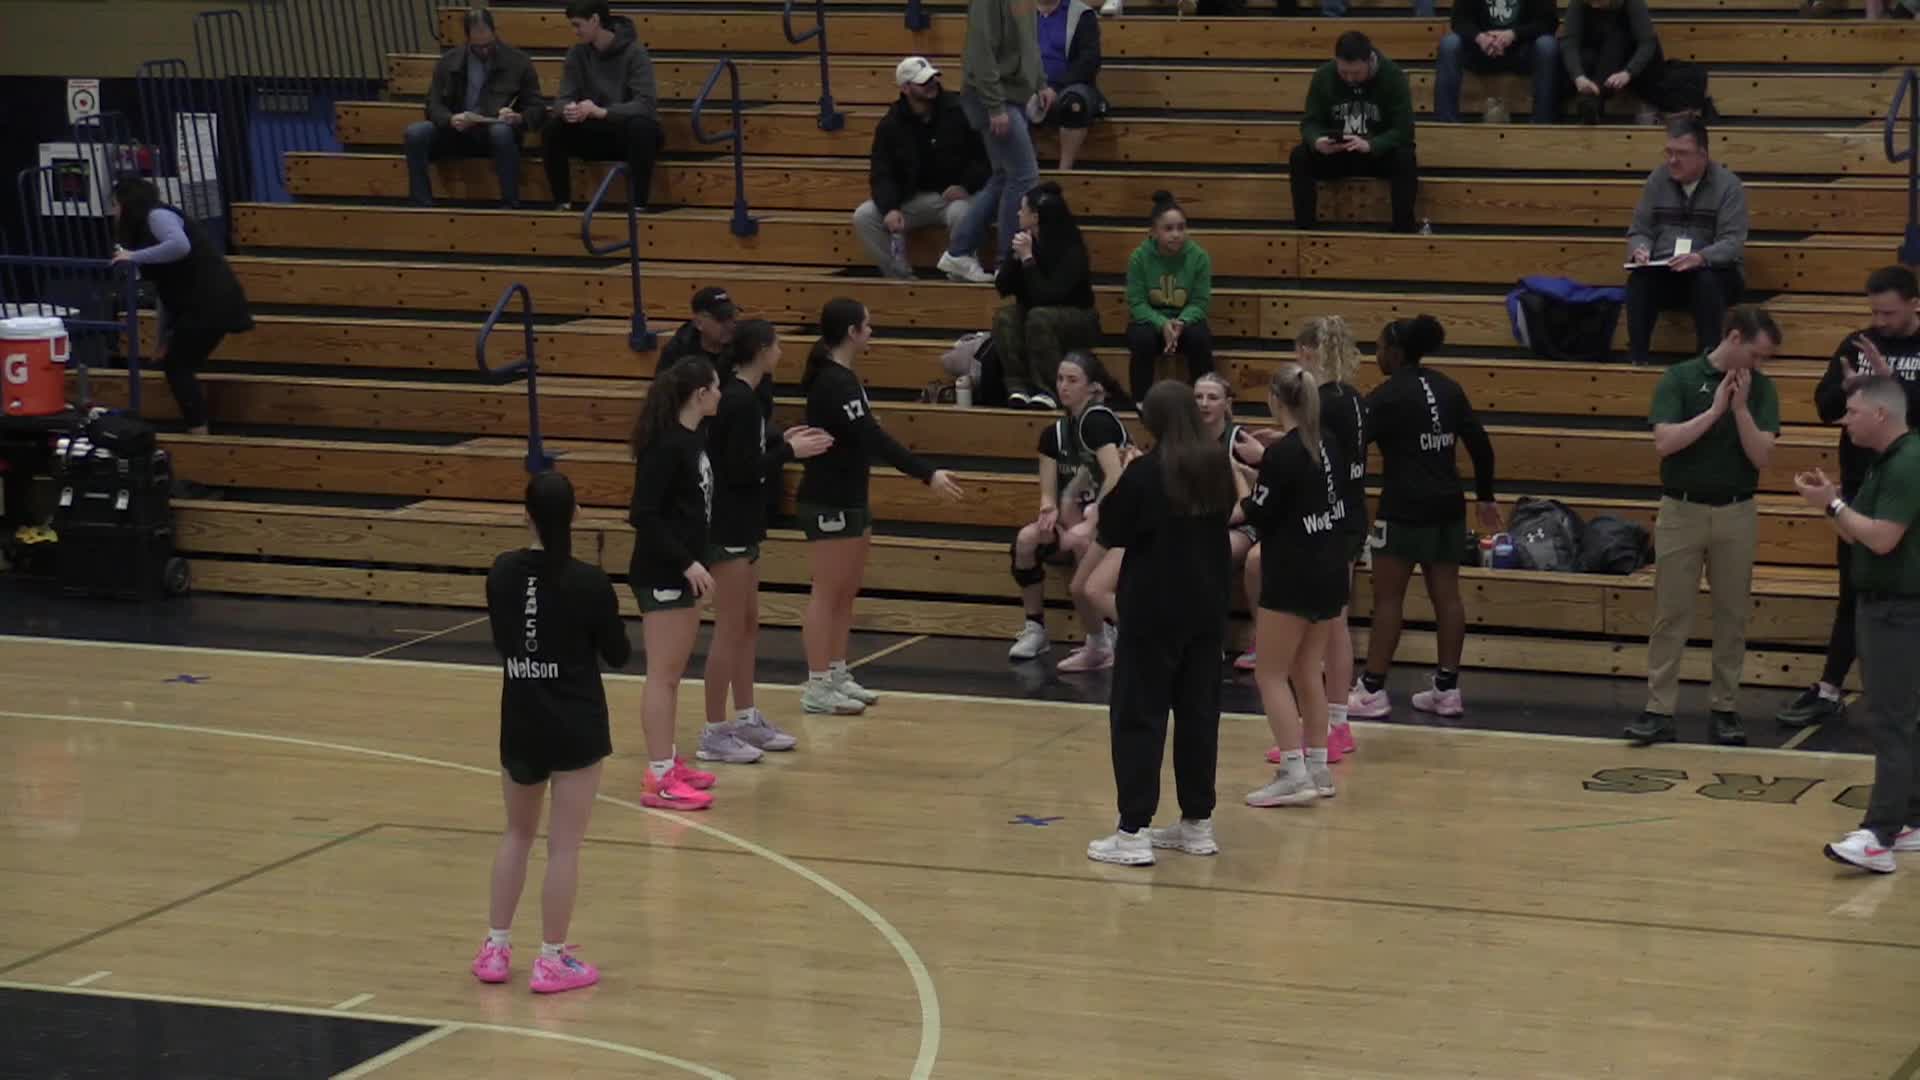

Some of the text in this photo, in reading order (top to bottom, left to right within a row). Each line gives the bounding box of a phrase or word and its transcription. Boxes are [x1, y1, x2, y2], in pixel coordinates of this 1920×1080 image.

[5, 353, 29, 384] G
[842, 399, 865, 421] 17
[506, 656, 560, 680] Nelson
